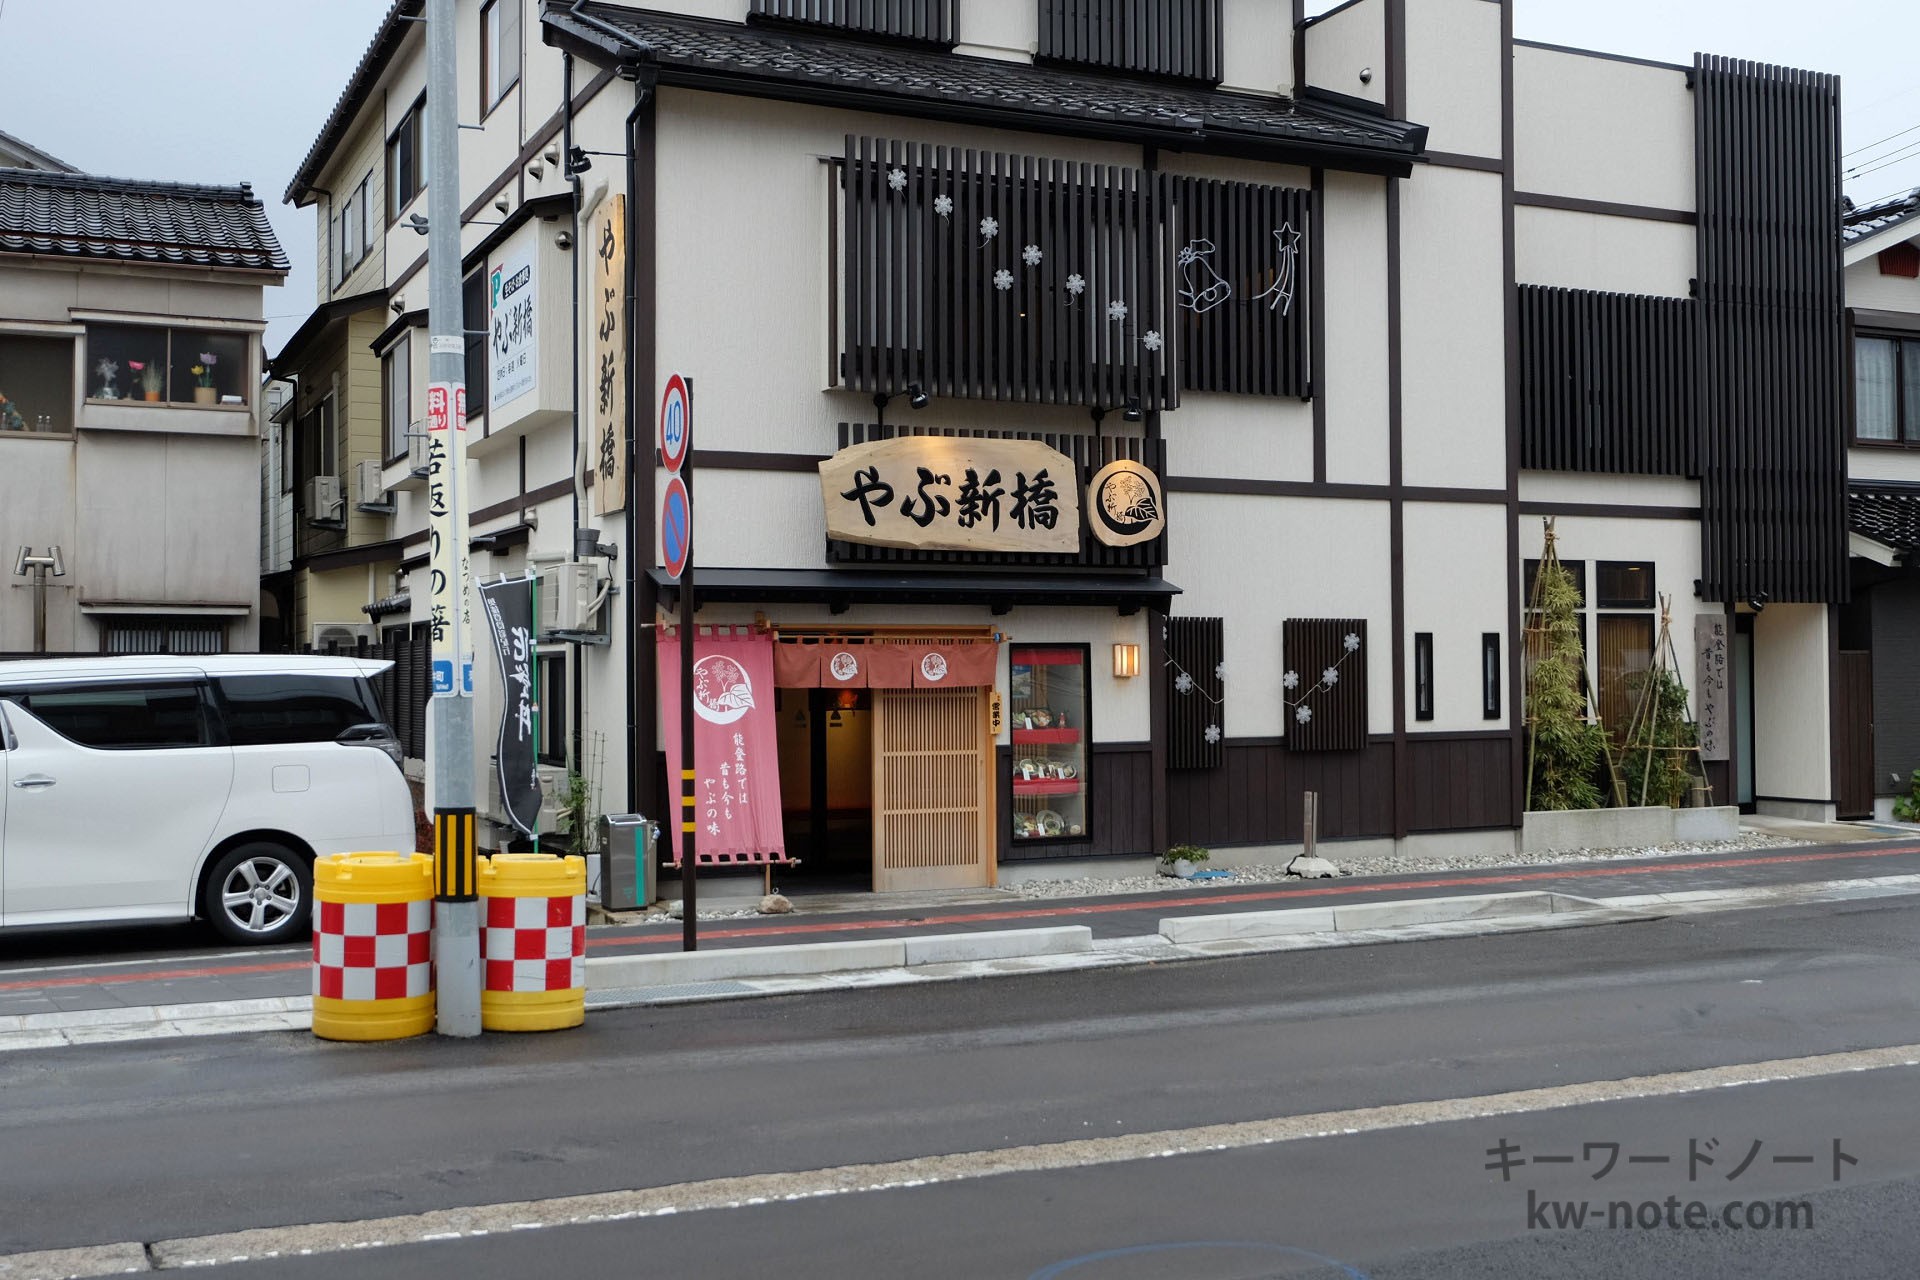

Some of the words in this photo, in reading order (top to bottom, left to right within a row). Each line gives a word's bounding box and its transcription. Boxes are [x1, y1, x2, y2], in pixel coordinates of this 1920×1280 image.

[491, 270, 501, 309] P
[493, 295, 533, 359] やぶ新橋
[598, 218, 616, 481] やぶ新橋
[666, 400, 682, 446] 40
[839, 465, 1060, 533] やぶ新橋
[1714, 623, 1726, 690] 能登路では
[719, 761, 734, 820] 昔も今も
[733, 732, 749, 804] 能登路では
[704, 777, 721, 836] やぶの味
